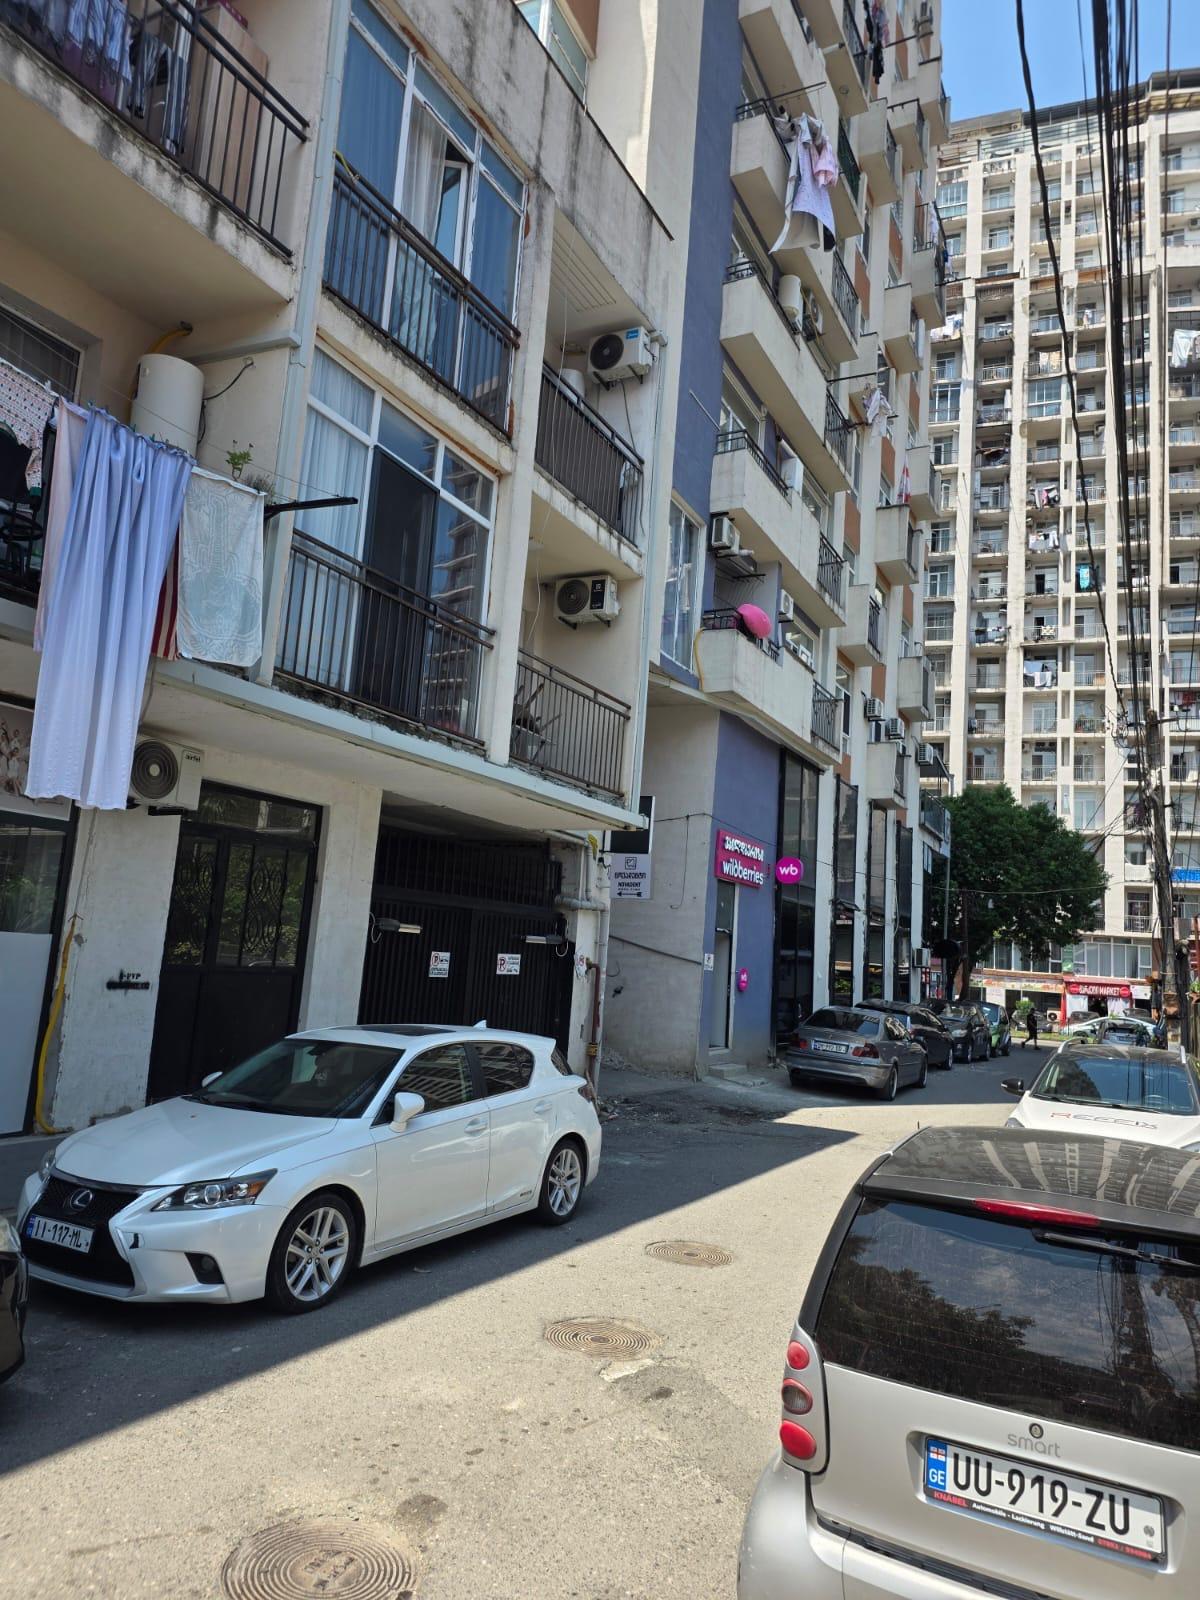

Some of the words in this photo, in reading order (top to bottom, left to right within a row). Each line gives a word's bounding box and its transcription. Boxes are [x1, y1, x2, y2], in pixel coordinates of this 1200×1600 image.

[722, 858, 764, 885] wildberries
[779, 864, 799, 876] wb
[1007, 1433, 1061, 1458] smart
[929, 1468, 945, 1486] GE
[953, 1452, 1130, 1536] UU-919-ZU
